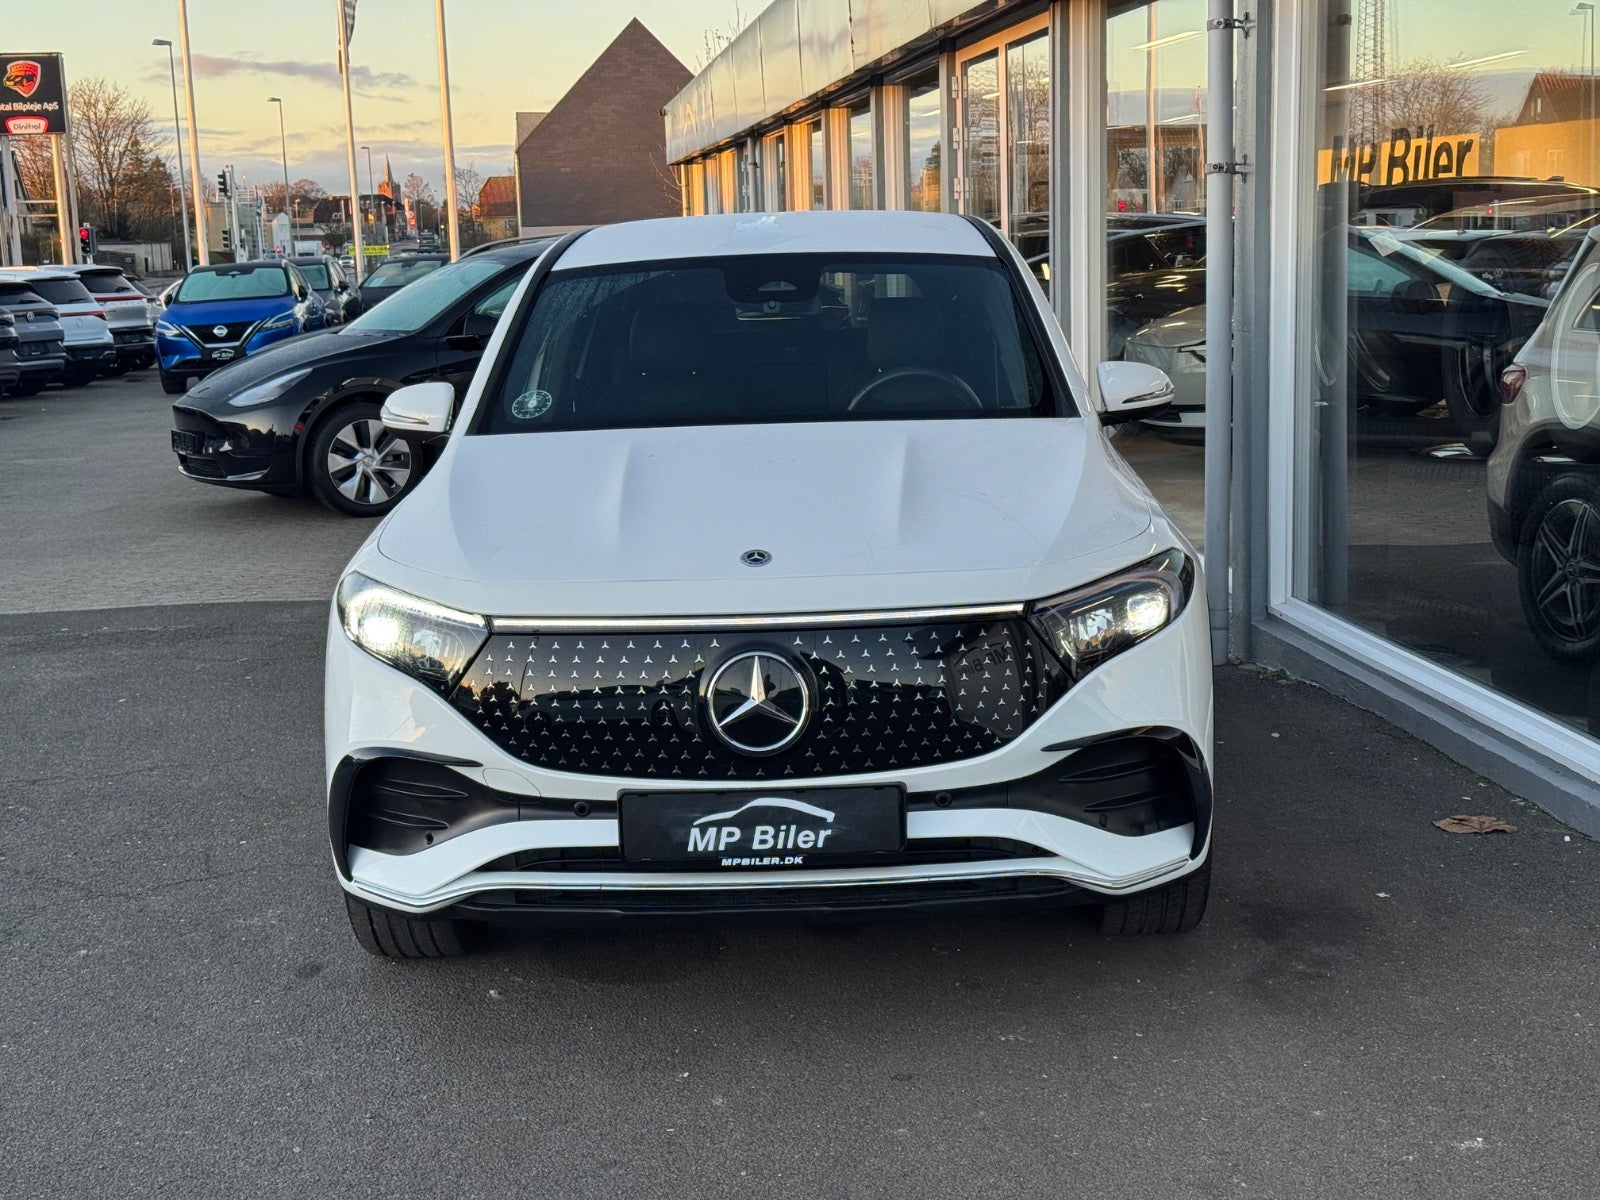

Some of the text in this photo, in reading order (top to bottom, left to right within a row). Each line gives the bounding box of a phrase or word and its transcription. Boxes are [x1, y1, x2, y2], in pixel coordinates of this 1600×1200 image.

[13, 102, 42, 112] Bilpleje
[43, 102, 59, 111] ApS
[1386, 124, 1474, 185] Biler
[687, 825, 832, 852] MP Biler
[721, 856, 804, 867] MPBILER.DK
